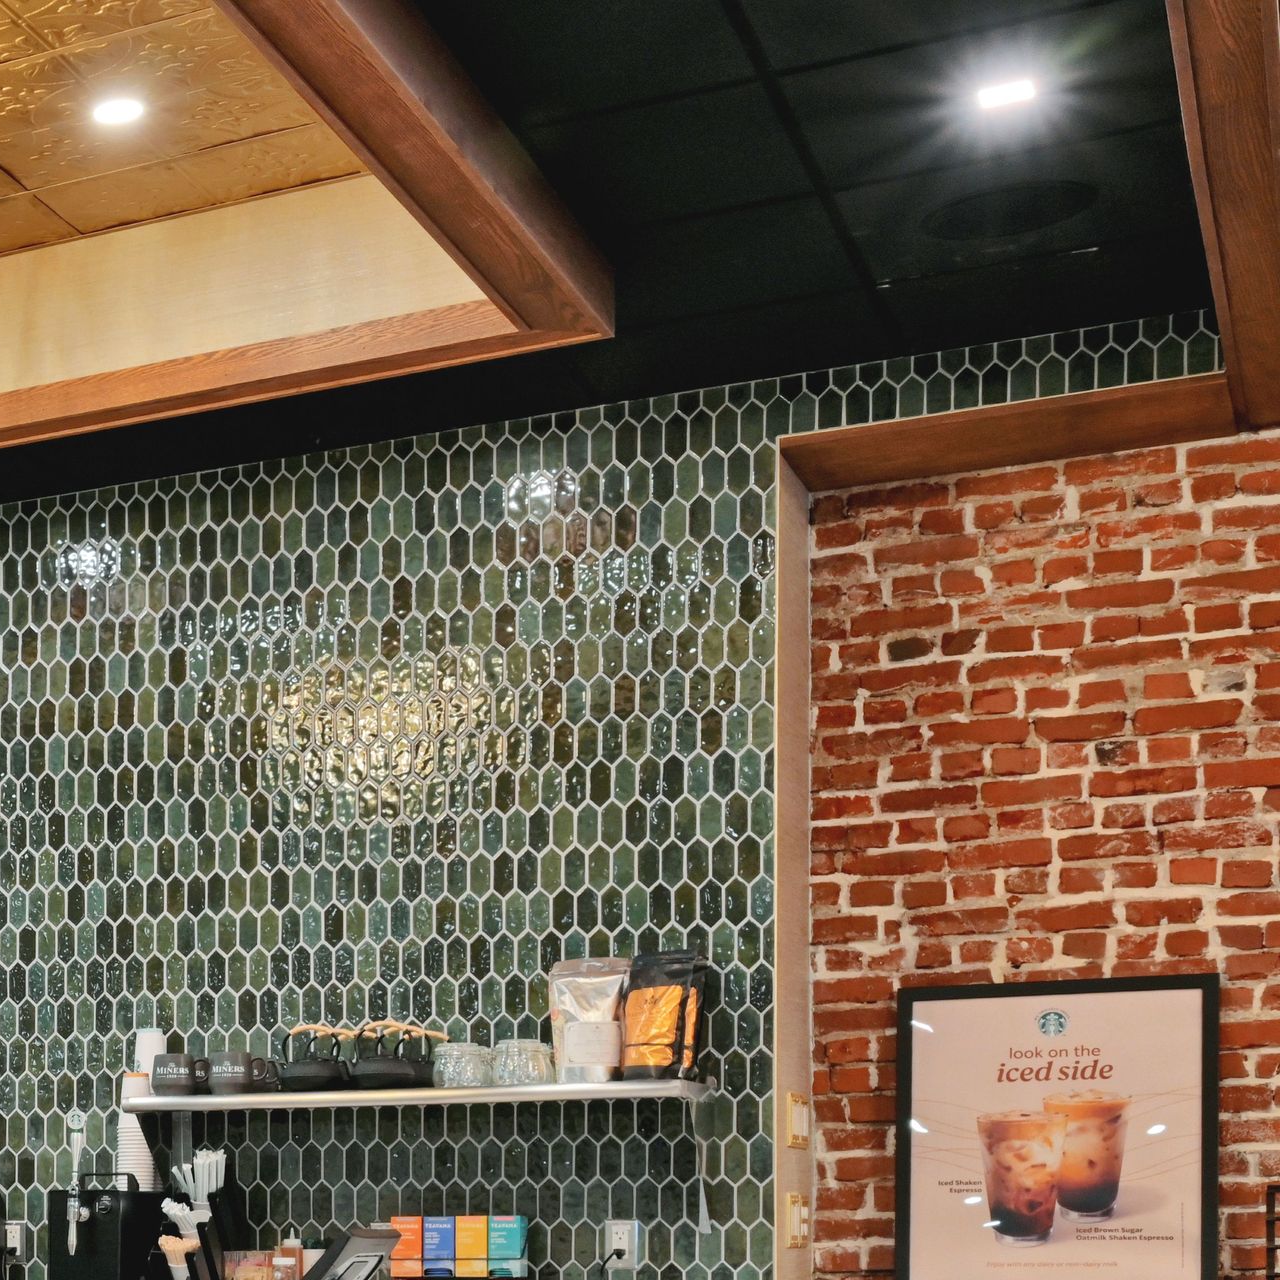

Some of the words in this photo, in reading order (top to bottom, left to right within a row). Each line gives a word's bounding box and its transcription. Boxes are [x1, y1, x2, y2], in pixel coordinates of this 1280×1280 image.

[1009, 1047, 1043, 1059] look
[1048, 1048, 1069, 1058] on
[1074, 1045, 1101, 1057] the
[997, 1061, 1053, 1083] iced
[1057, 1059, 1114, 1081] side
